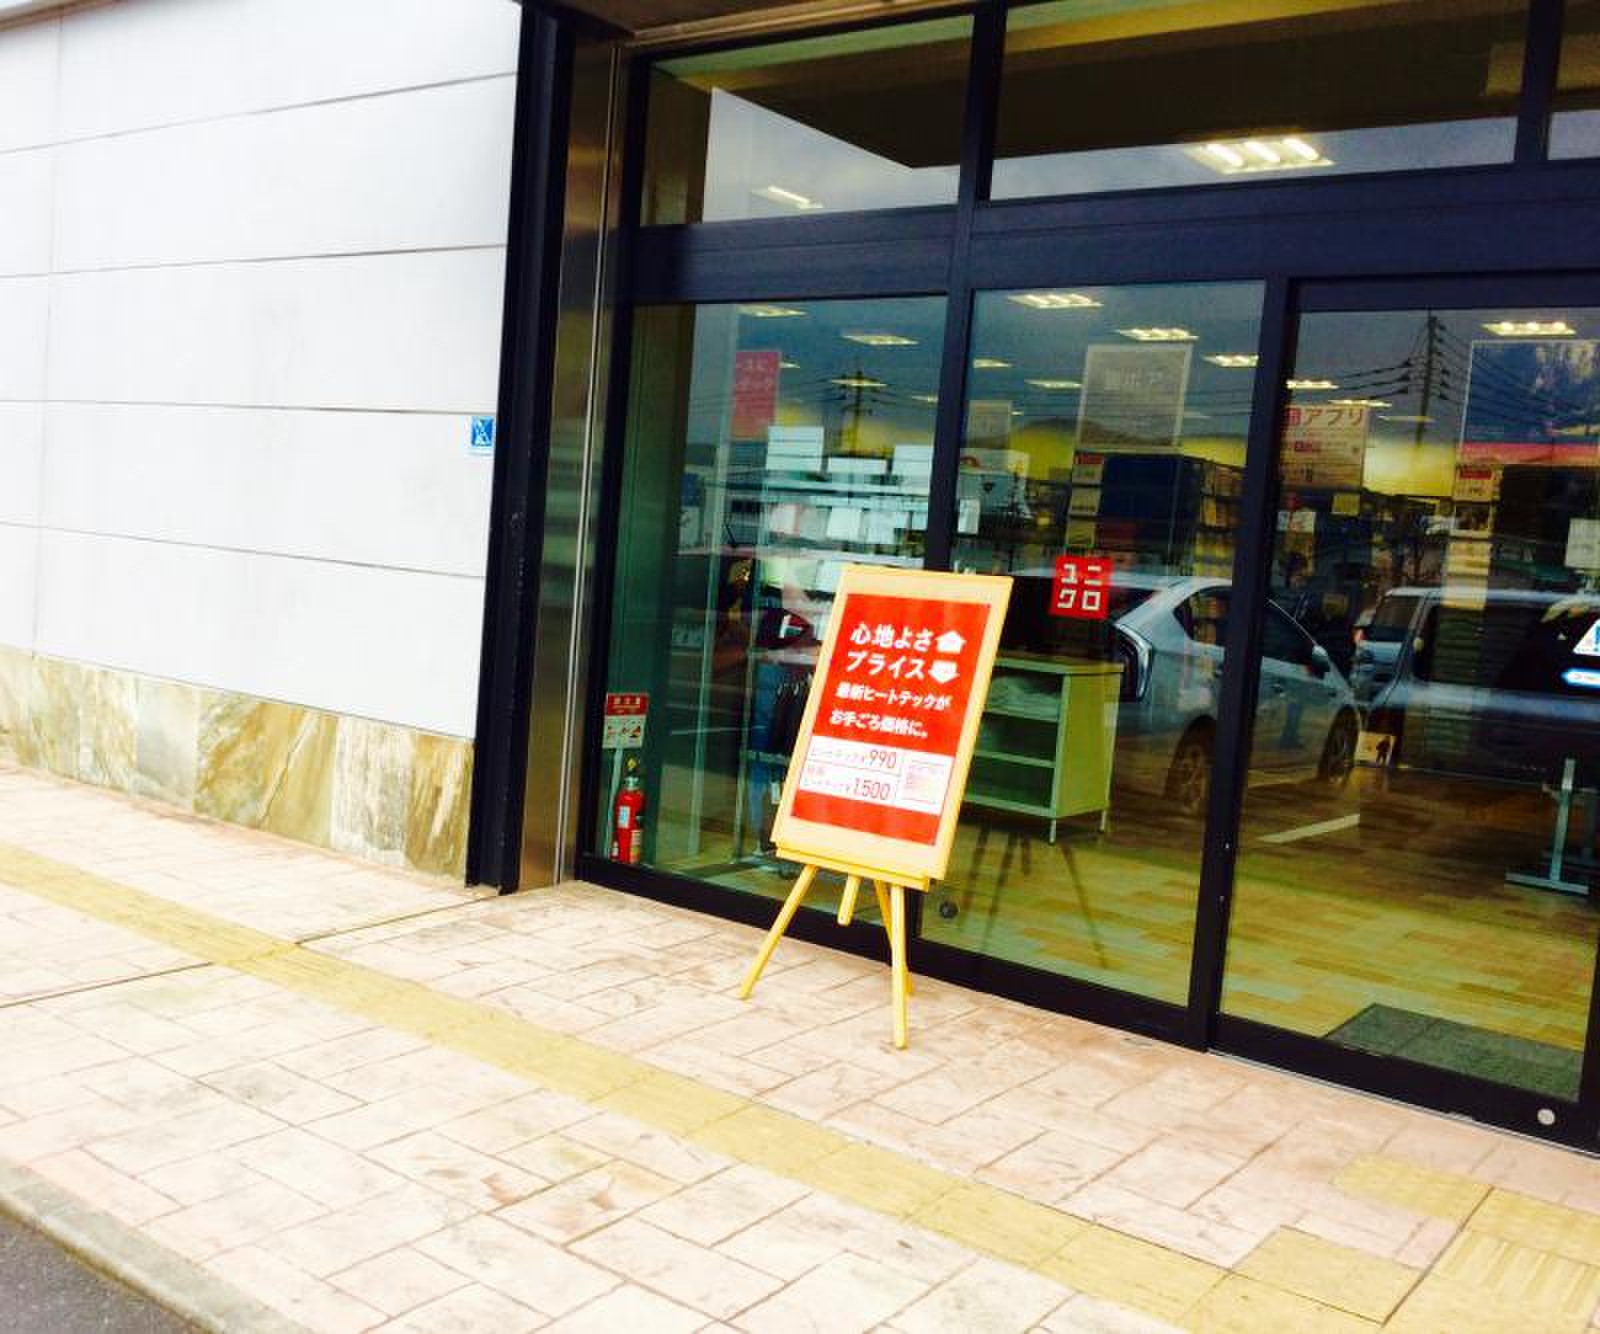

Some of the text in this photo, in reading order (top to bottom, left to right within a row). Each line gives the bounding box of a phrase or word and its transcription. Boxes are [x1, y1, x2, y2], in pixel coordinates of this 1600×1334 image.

[850, 621, 935, 653] 心地よさ
[846, 650, 925, 680] プライス
